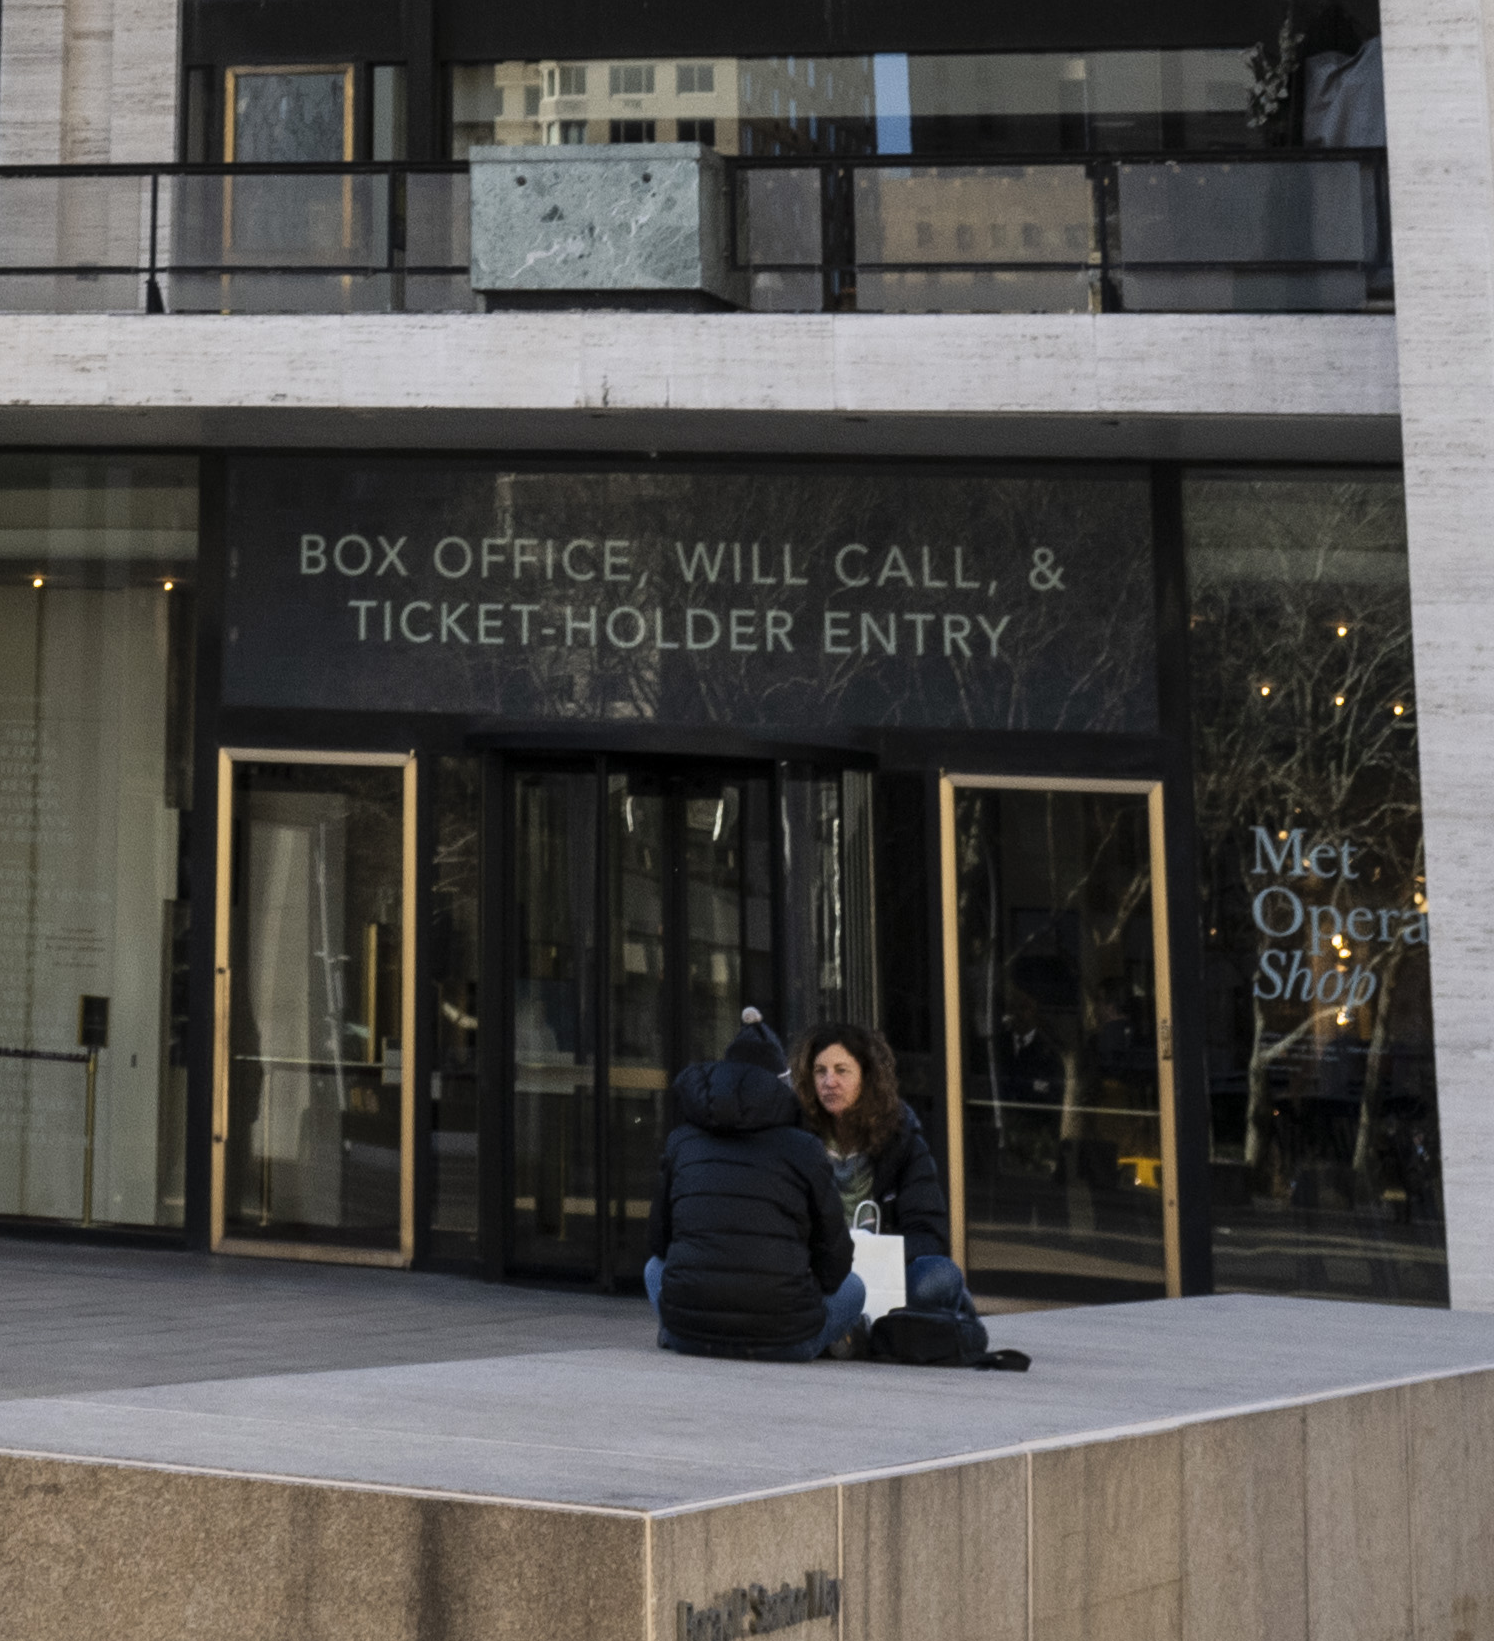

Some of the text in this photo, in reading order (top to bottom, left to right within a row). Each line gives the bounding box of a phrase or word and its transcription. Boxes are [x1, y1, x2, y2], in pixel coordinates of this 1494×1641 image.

[300, 533, 1066, 595] BOX OFFICE, WILL CALL, &
[348, 599, 1012, 659] TICKET-HOLDER ENTRY
[1249, 824, 1360, 880] Met
[1251, 885, 1429, 958] Opera
[1253, 948, 1378, 1022] Shop
